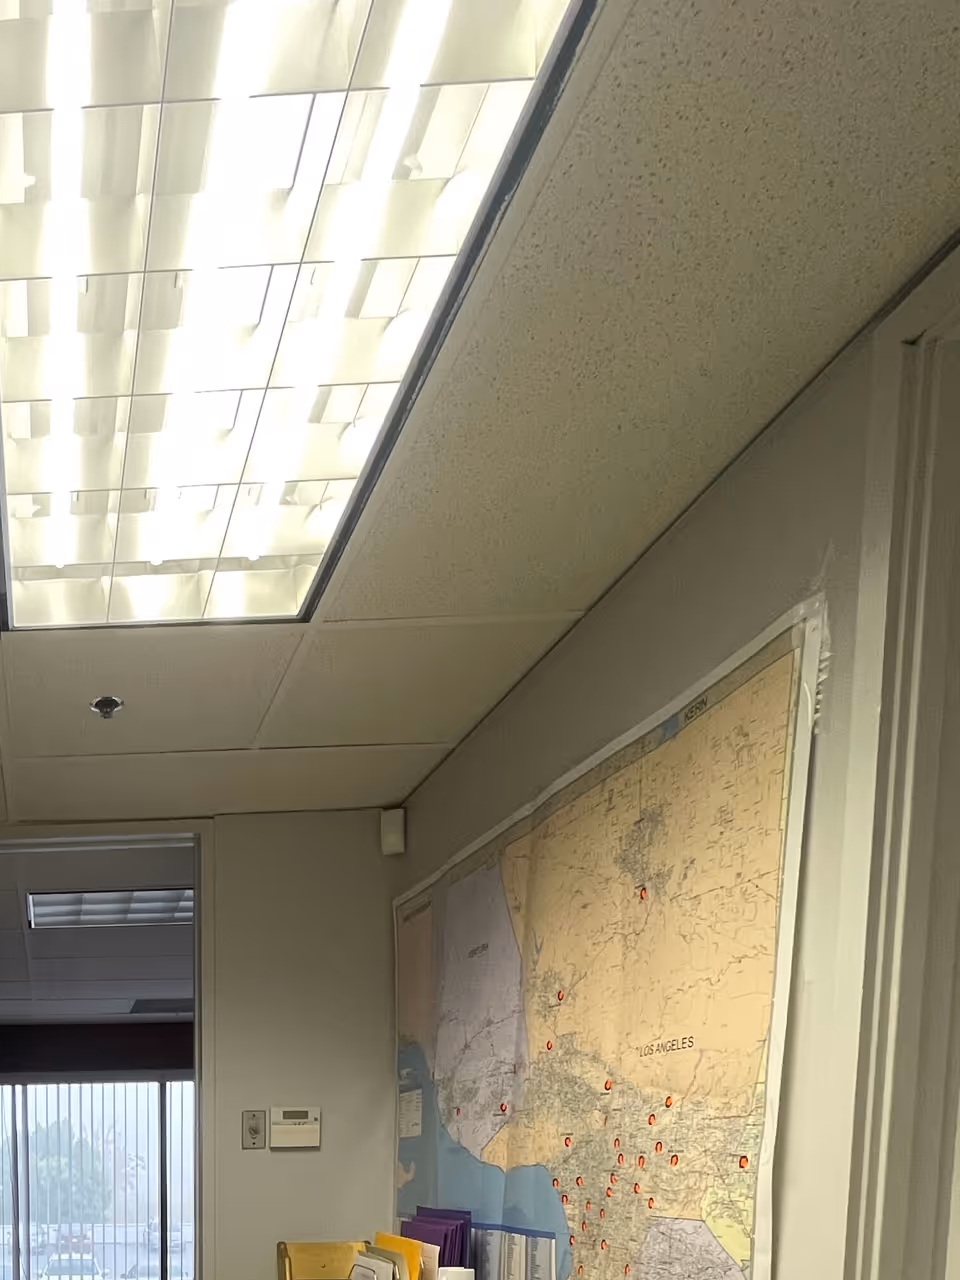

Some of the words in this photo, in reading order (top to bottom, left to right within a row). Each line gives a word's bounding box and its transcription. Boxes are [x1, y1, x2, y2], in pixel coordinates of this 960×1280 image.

[684, 695, 708, 722] KERN
[640, 1043, 654, 1058] LOS
[655, 1036, 695, 1053] ANGELES
